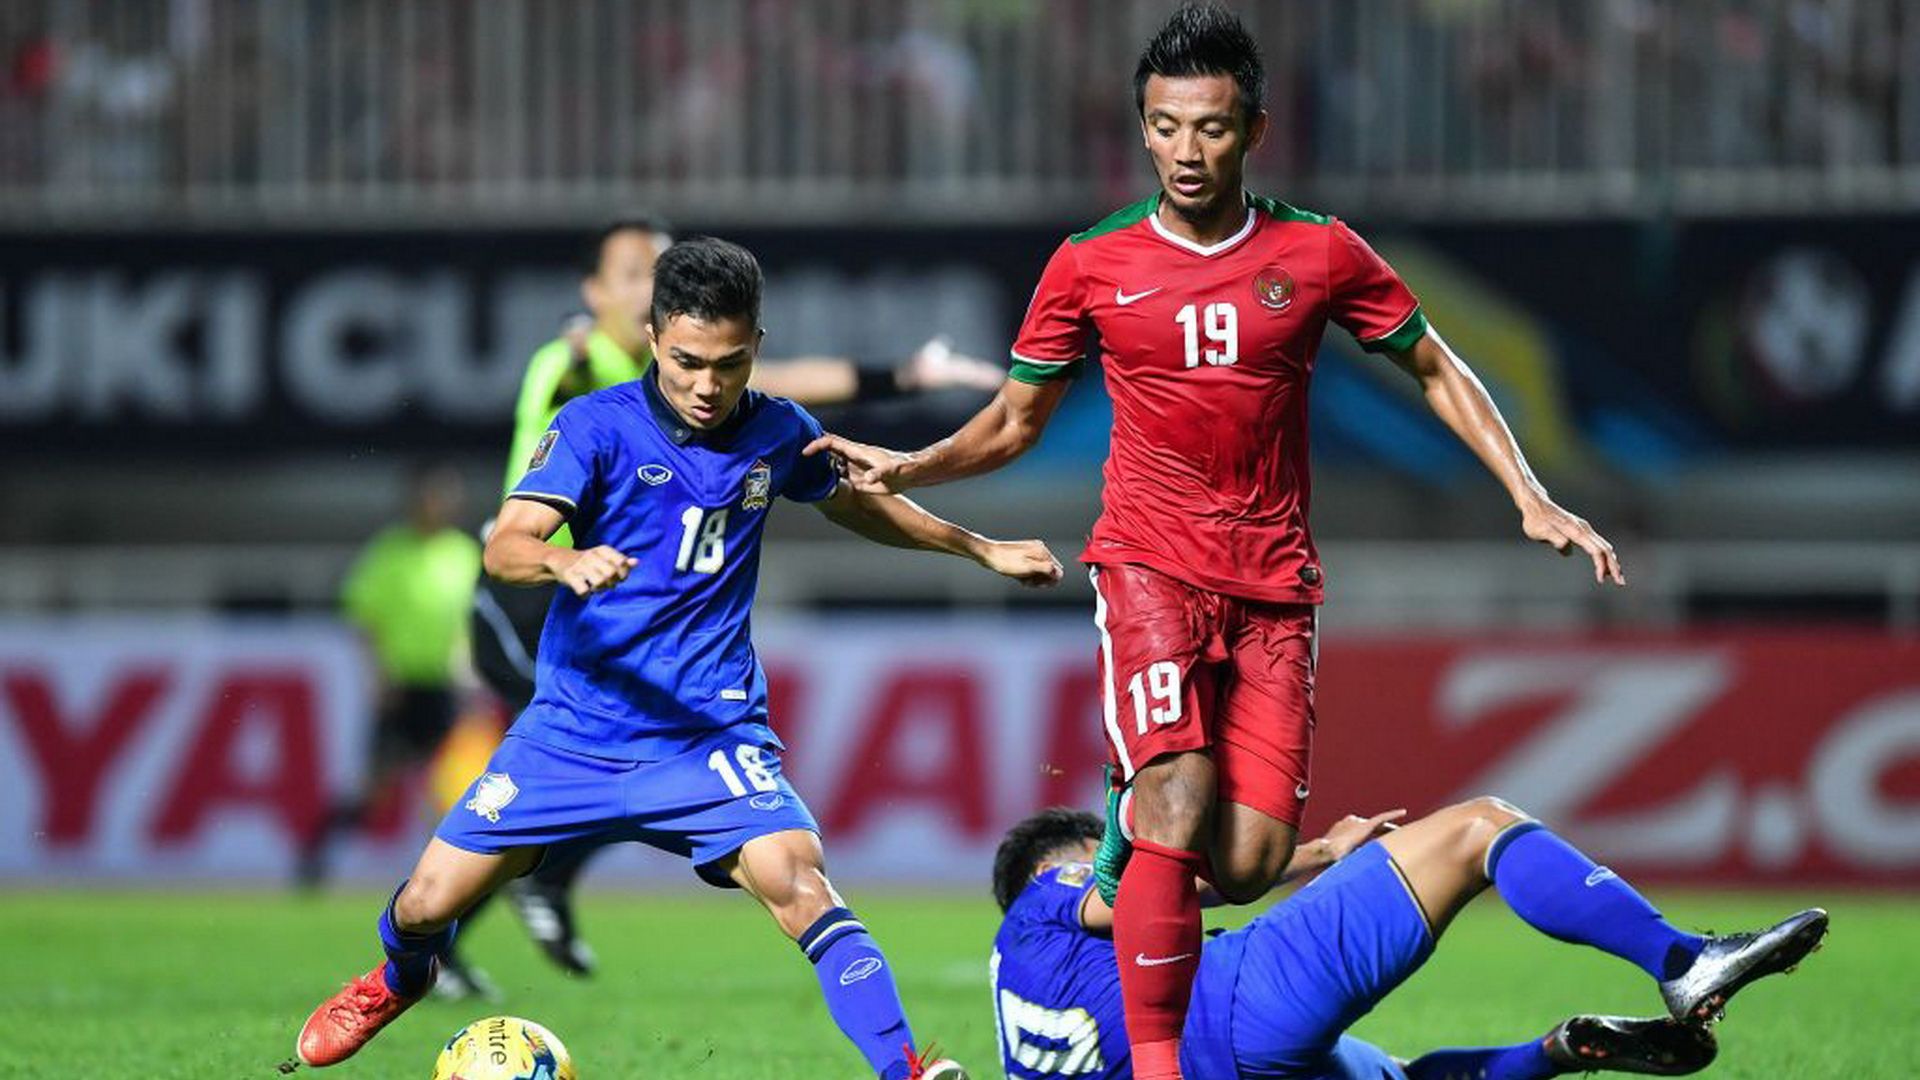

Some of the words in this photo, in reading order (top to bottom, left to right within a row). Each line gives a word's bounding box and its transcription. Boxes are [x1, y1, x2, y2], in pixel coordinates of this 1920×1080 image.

[1175, 302, 1239, 368] 19
[676, 506, 729, 574] 18
[1127, 660, 1182, 736] 19
[708, 744, 779, 797] 18
[488, 1018, 510, 1066] mitre
